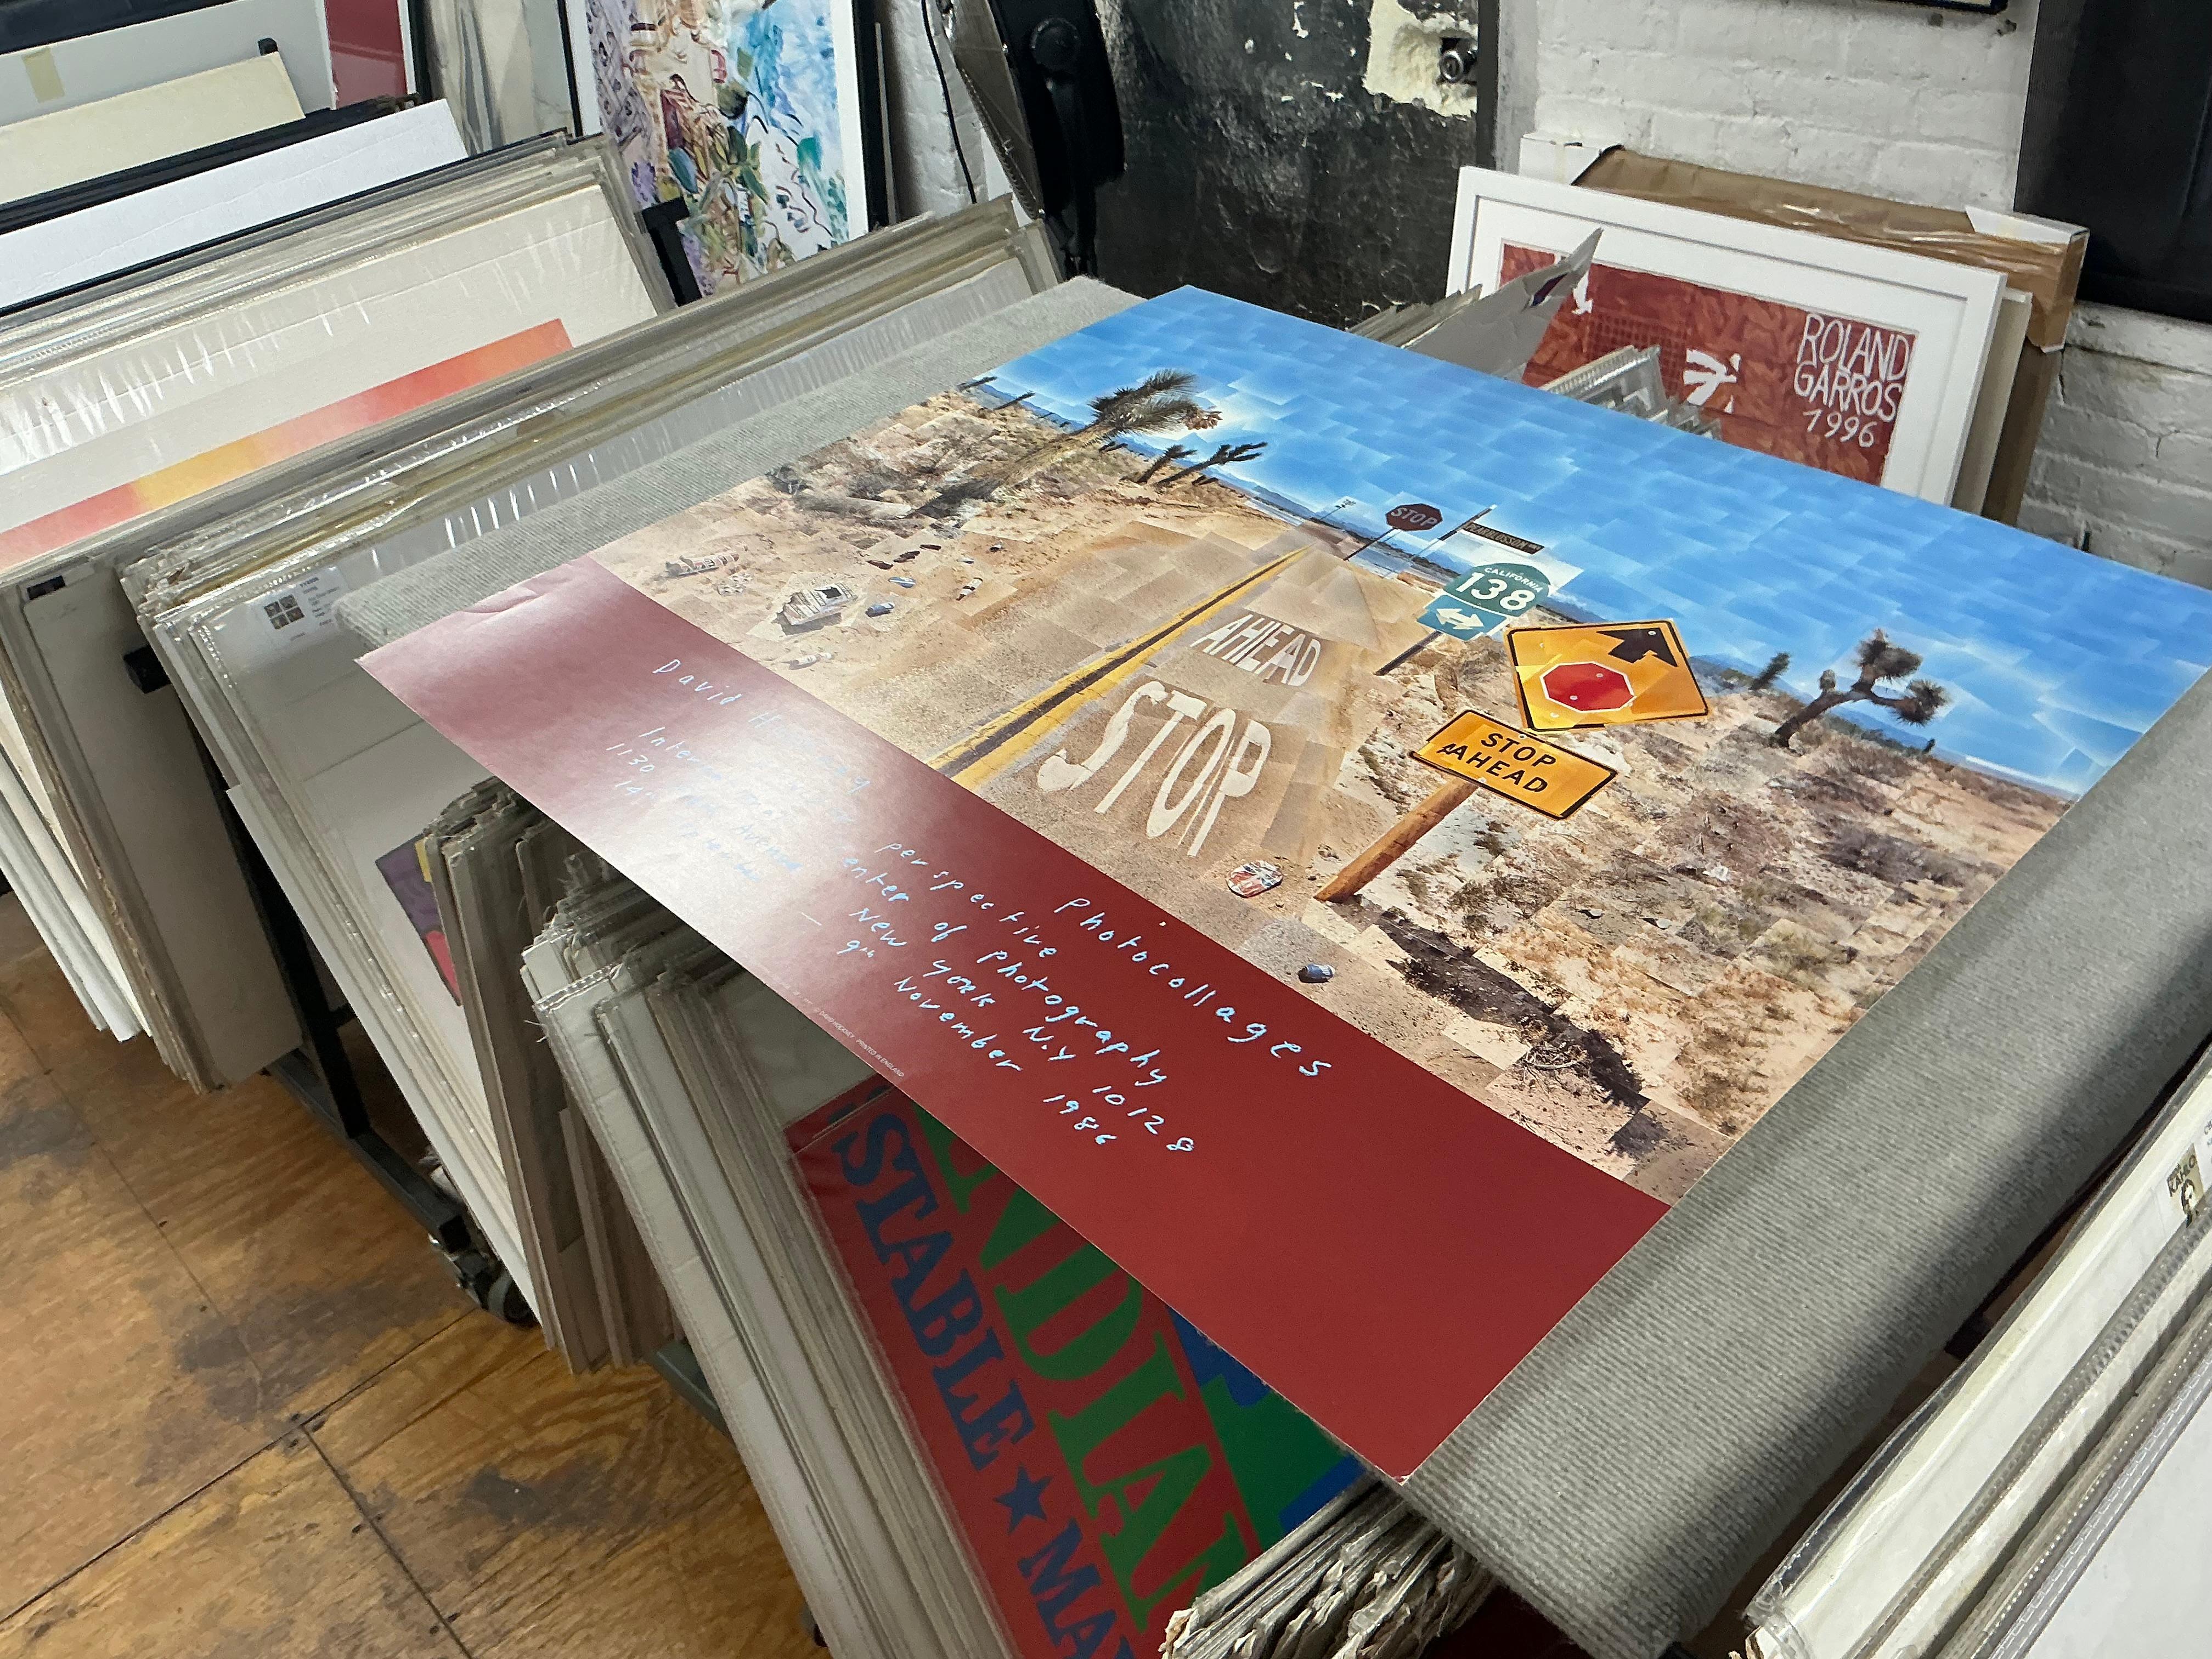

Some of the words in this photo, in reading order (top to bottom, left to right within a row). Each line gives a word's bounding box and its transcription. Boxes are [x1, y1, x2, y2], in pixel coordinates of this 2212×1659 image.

[1797, 313, 1910, 382] ROLAND
[1793, 360, 1903, 422] GARROS
[1803, 409, 1878, 448] 1996
[1391, 507, 1438, 527] STOP
[1455, 571, 1536, 611] 138
[1483, 567, 1543, 594] CALIFORNIA
[1190, 613, 1321, 687] AHEAD
[1037, 681, 1272, 857] STOP
[1481, 732, 1557, 769] STOP
[652, 659, 742, 706] David
[1053, 898, 1333, 1077] Photocollages
[873, 843, 1058, 958] perspective
[605, 743, 655, 772] 1130
[849, 907, 908, 946] New
[1092, 1085, 1195, 1152] 10128
[930, 922, 967, 943] of
[879, 1057, 905, 1077] ENGLAND
[893, 975, 1023, 1071] November
[1043, 1094, 1118, 1145] 1986
[830, 1113, 1035, 1471] STABLE
[1017, 1516, 1136, 1659] MA
